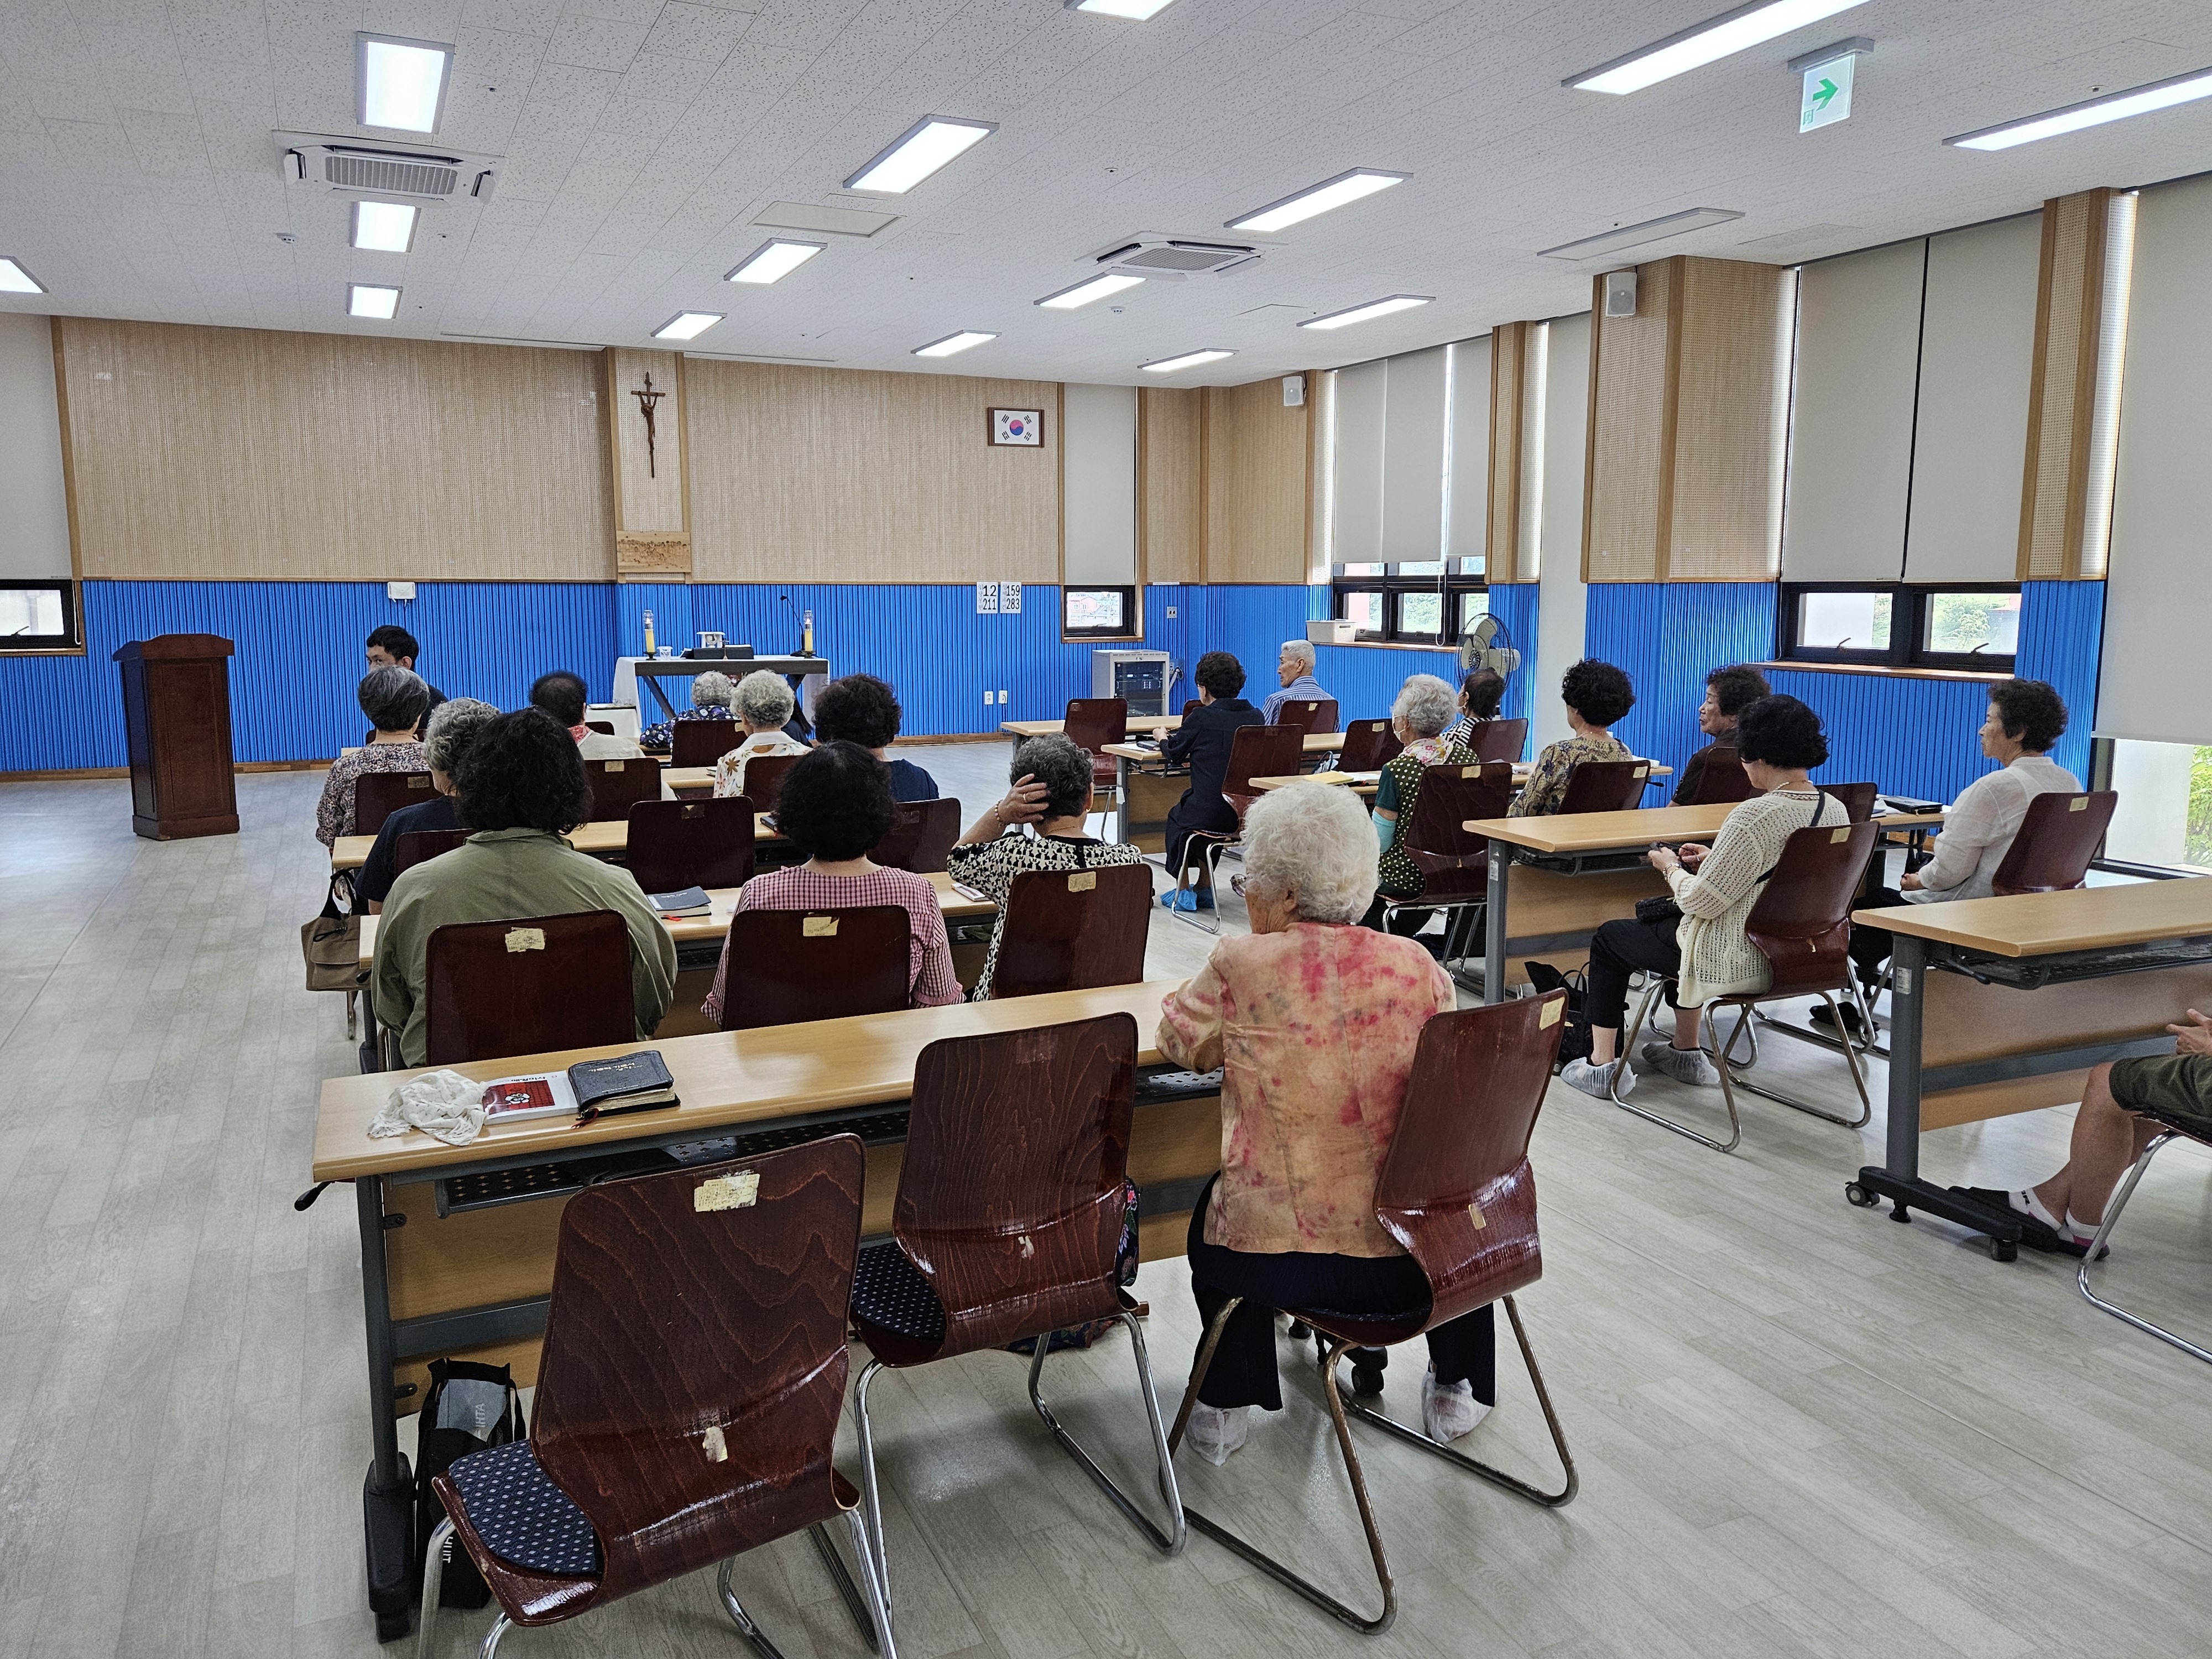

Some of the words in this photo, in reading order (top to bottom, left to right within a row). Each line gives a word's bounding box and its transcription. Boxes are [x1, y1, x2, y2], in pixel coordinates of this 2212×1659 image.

[983, 585, 997, 597] 12
[1006, 585, 1020, 596] 159
[983, 598, 997, 610] 211
[1006, 598, 1020, 609] 283
